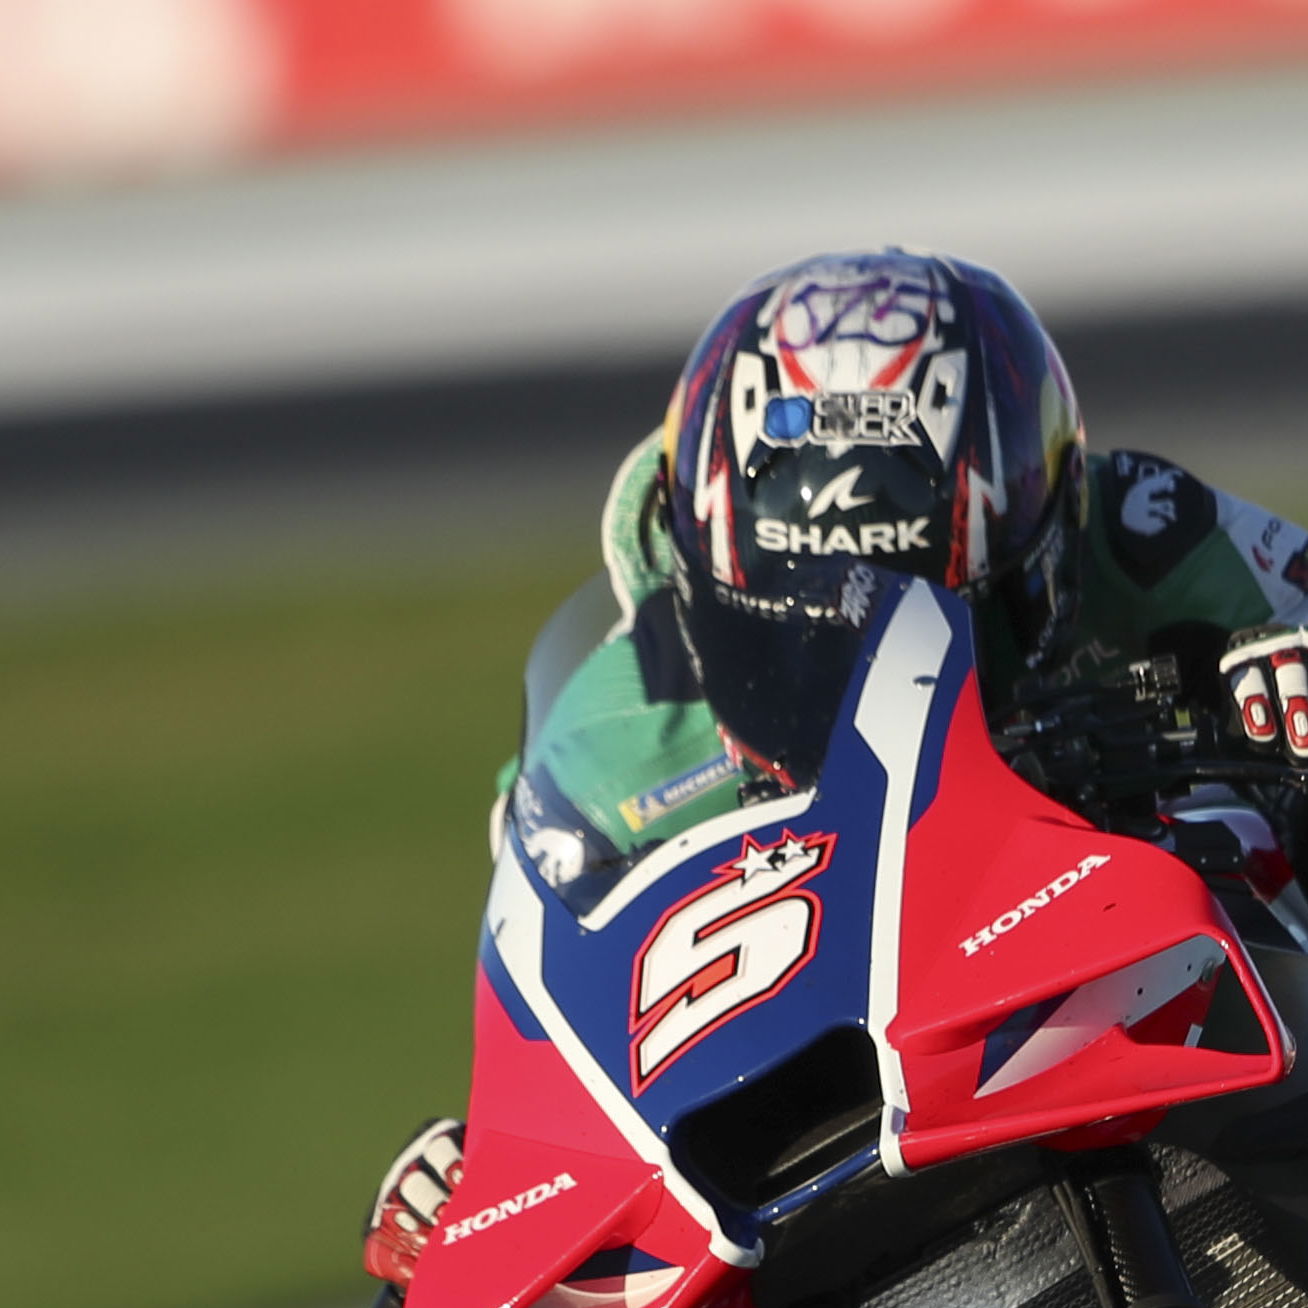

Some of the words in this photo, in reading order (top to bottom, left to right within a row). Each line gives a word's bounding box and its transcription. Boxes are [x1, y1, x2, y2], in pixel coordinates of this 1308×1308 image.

[755, 516, 931, 556] SHARK
[958, 854, 1112, 958] HONDA
[442, 1172, 578, 1246] HONDA
